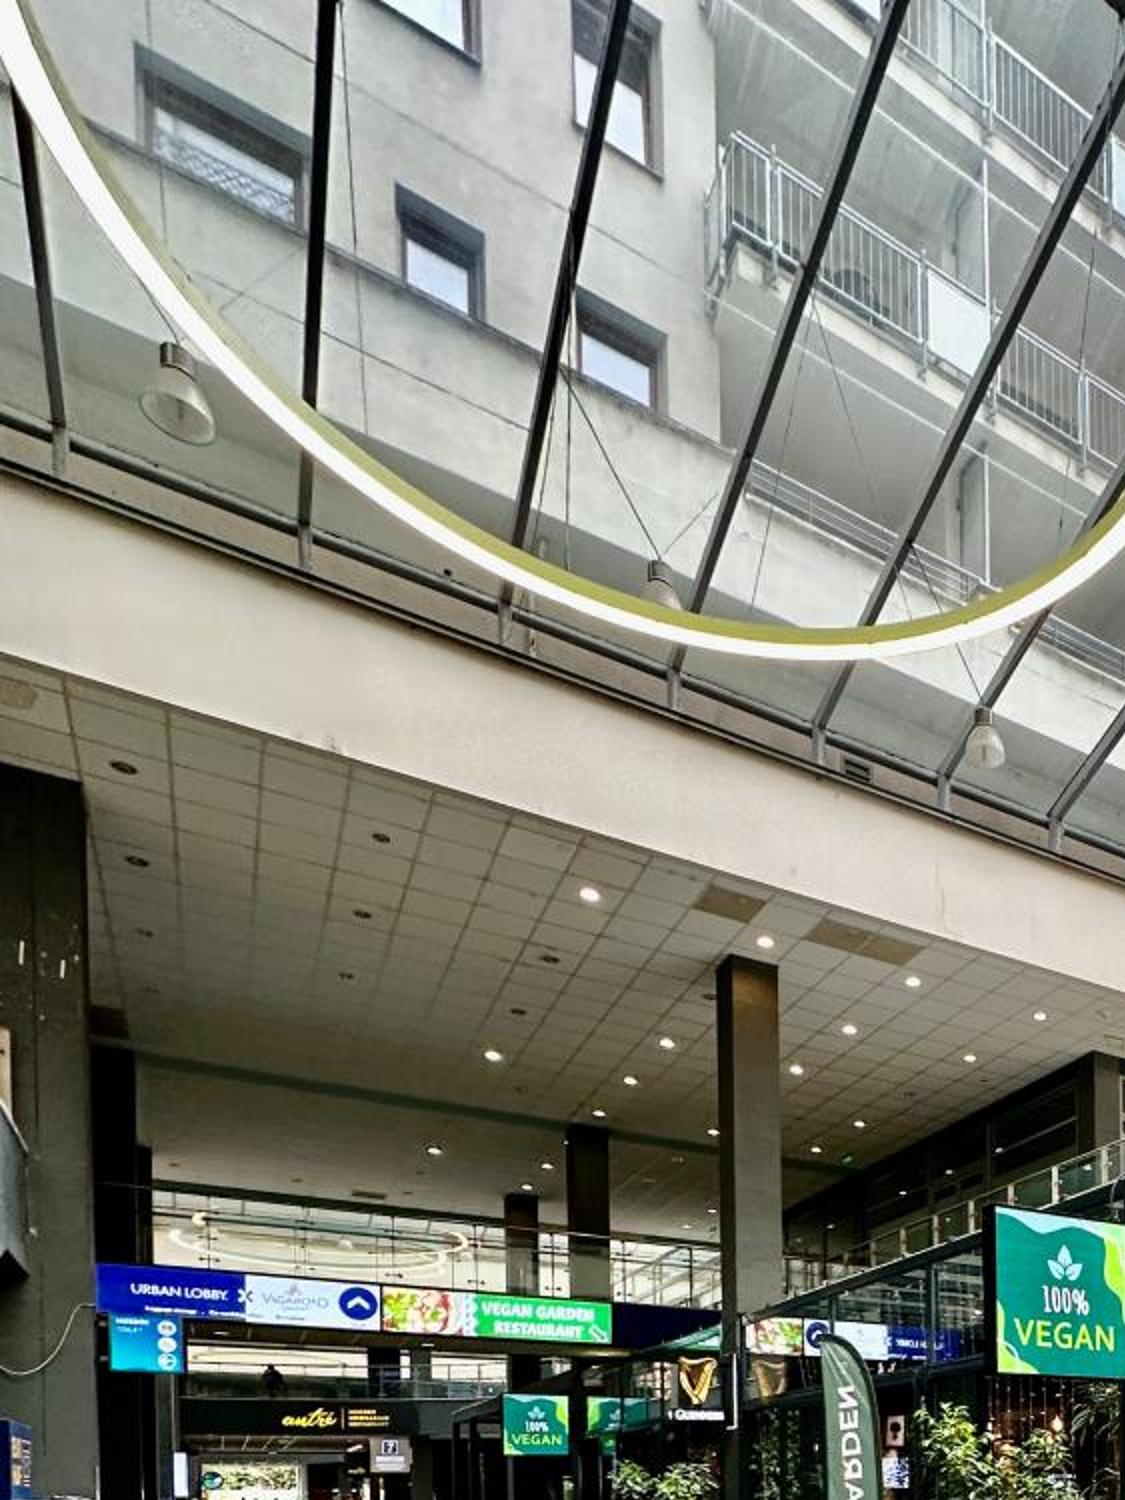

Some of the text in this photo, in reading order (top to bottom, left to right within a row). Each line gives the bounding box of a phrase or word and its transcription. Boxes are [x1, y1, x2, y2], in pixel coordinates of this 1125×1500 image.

[130, 1283, 183, 1299] URBAN
[1042, 1285, 1090, 1316] 100%
[481, 1301, 595, 1322] VEGAN GARDEN
[493, 1321, 584, 1340] RESTAURANT
[1014, 1317, 1116, 1353] VEGAN
[511, 1433, 562, 1446] VEGAN
